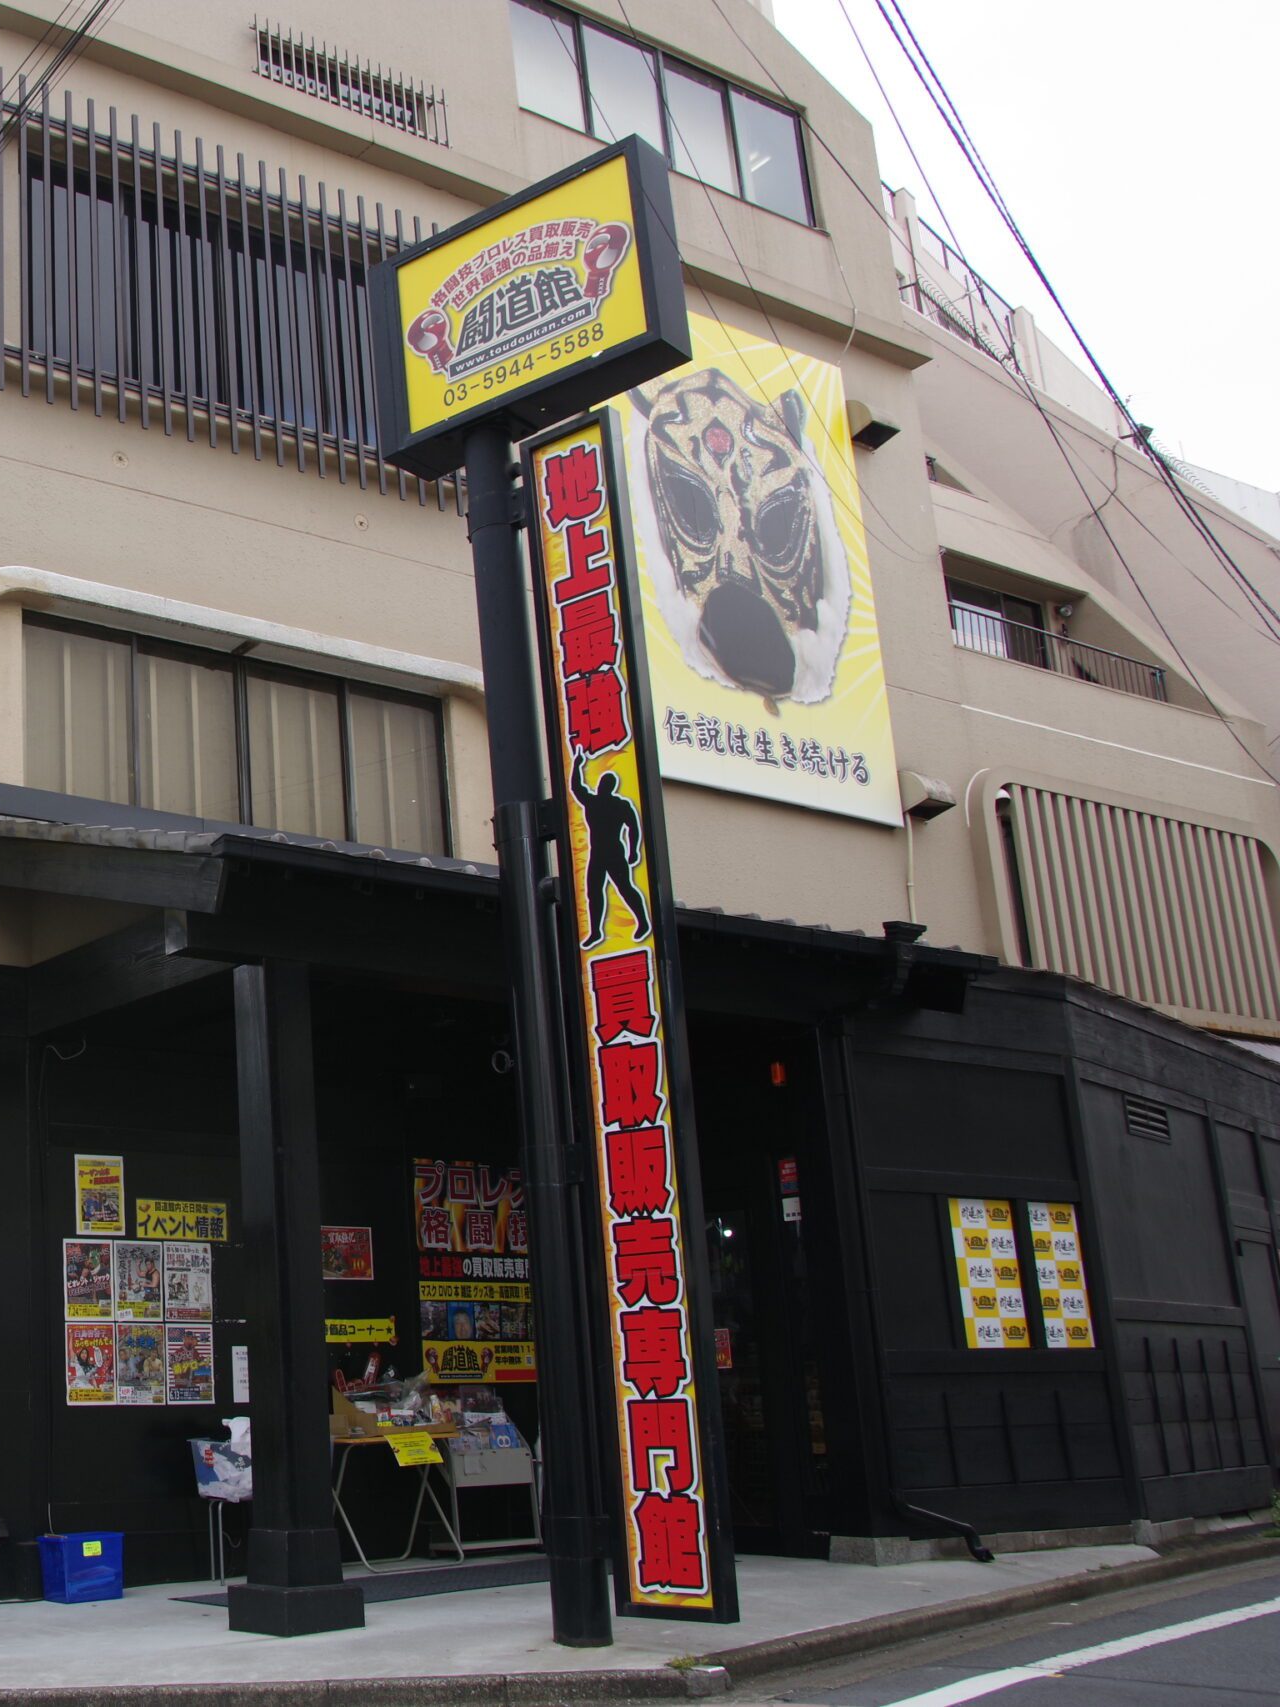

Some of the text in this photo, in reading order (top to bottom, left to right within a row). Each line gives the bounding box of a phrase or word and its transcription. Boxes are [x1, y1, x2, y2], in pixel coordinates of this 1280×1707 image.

[431, 220, 594, 308] 格闘技プロレス買取販売
[451, 241, 576, 309] 世界最強の品揃え
[455, 268, 584, 356] 闘道館
[455, 307, 587, 373] www.toudoukan.com
[443, 322, 605, 407] 03-5944-5588
[664, 707, 870, 786] 伝説は生き続ける
[543, 443, 707, 1592] 地上最強 買取販売専門館
[138, 1214, 224, 1239] イベント情報
